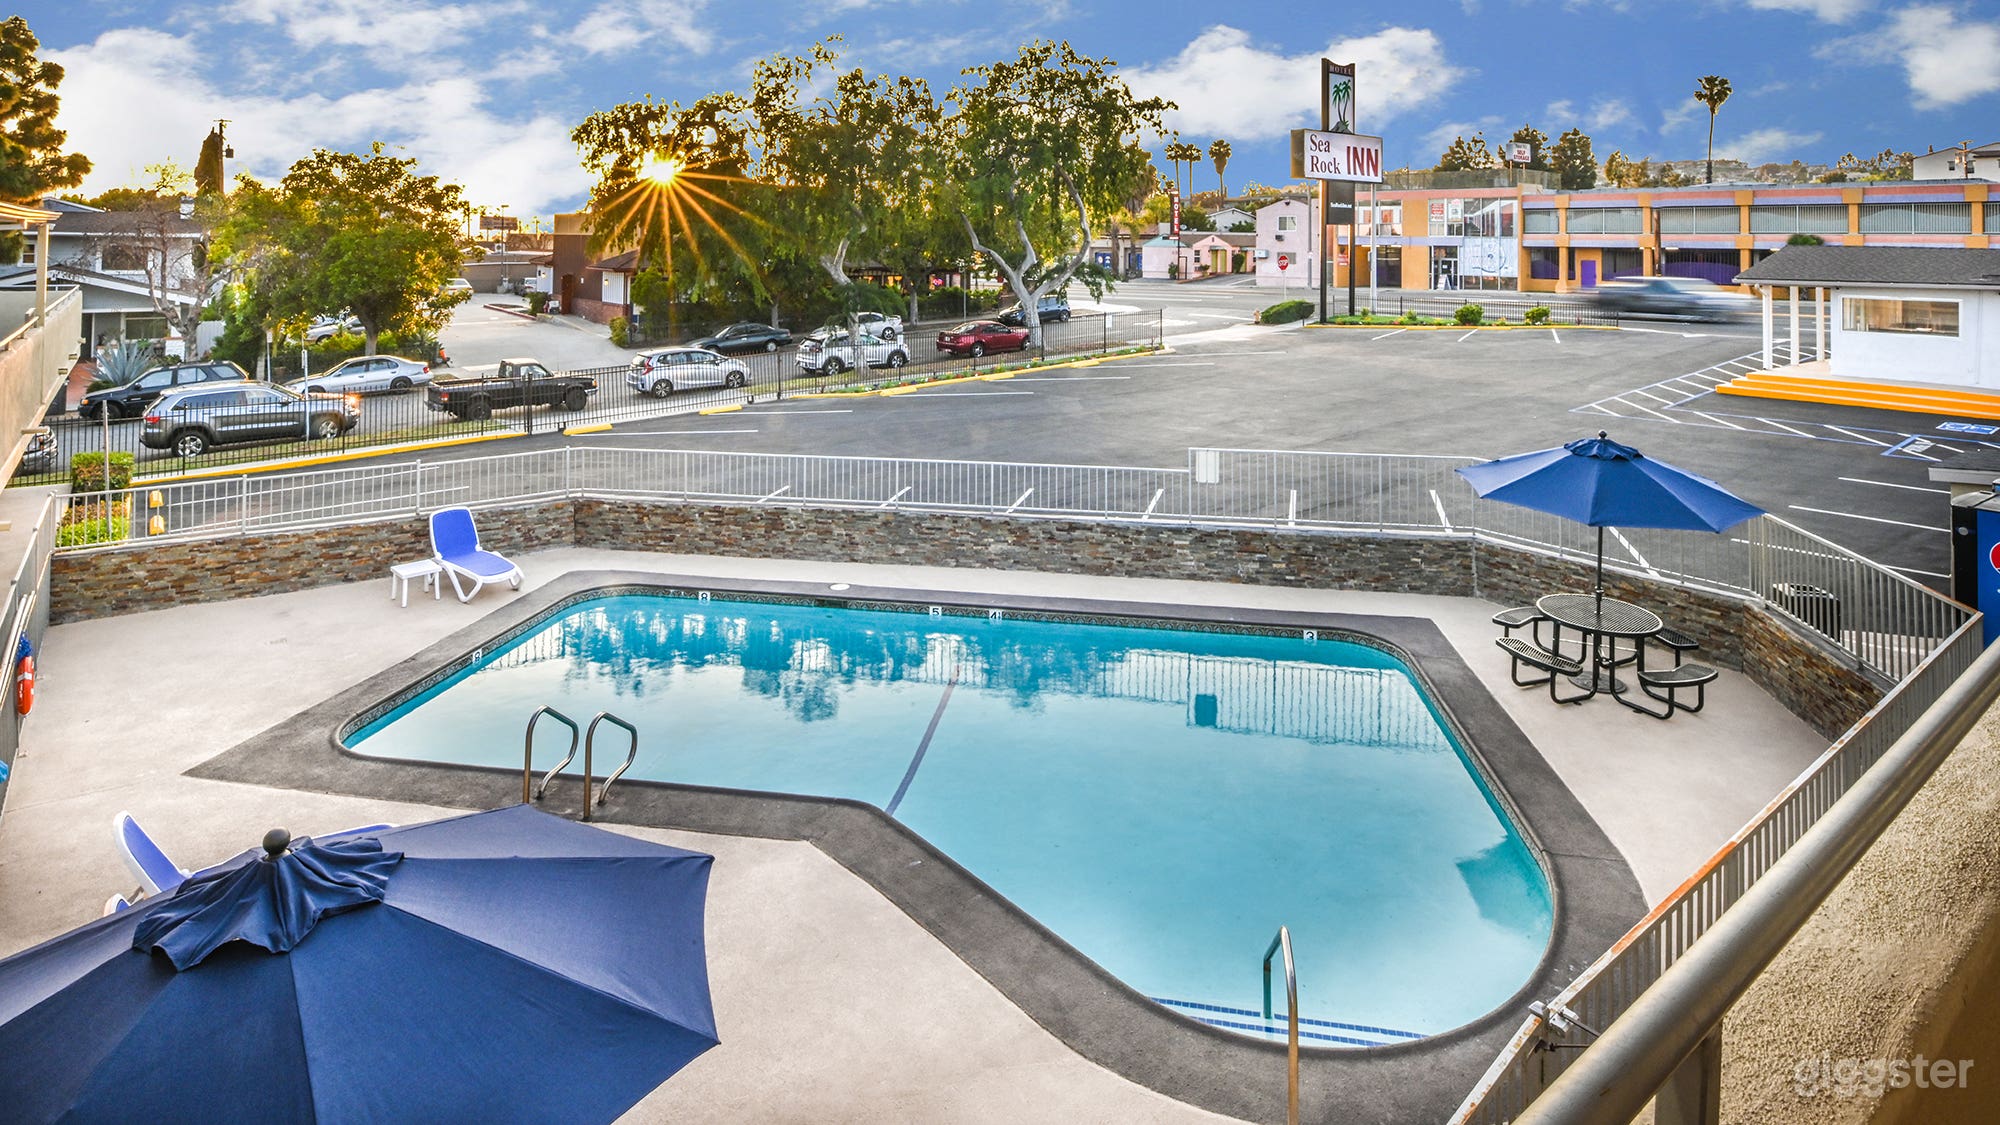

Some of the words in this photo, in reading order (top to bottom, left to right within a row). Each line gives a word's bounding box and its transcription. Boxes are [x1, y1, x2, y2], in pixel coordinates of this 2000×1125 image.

[1329, 64, 1353, 75] MOTEL
[1310, 134, 1330, 153] Sea
[1310, 155, 1341, 175] Rock
[1346, 146, 1379, 177] INN
[932, 607, 940, 616] 5
[1306, 631, 1314, 640] 3
